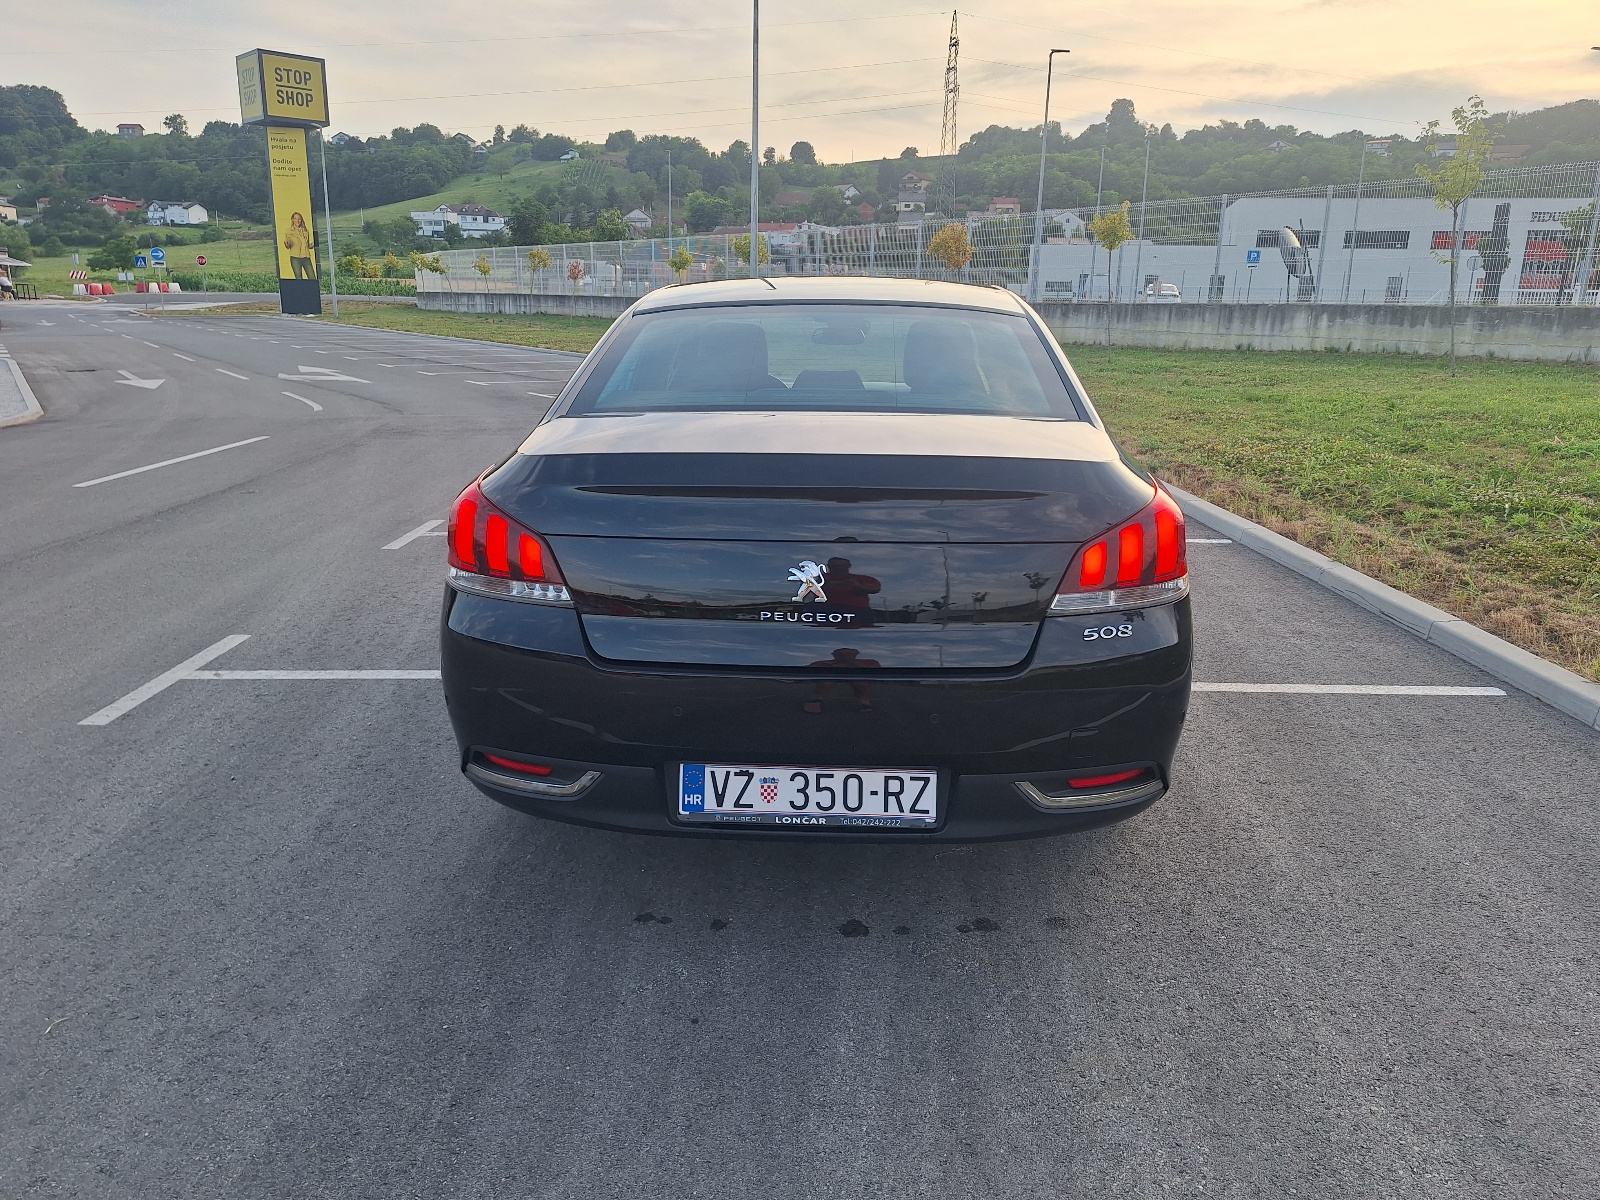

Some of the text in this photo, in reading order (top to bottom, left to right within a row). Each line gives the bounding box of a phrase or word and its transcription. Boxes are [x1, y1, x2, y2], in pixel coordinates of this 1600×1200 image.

[242, 67, 254, 84] STOP
[274, 67, 312, 86] STOP
[276, 89, 314, 108] SHOP
[760, 611, 855, 623] PEUGEOT
[1083, 624, 1133, 641] 508
[684, 793, 702, 806] HR
[710, 769, 931, 815] VŽ 350-RZ
[775, 815, 827, 825] LONČAR
